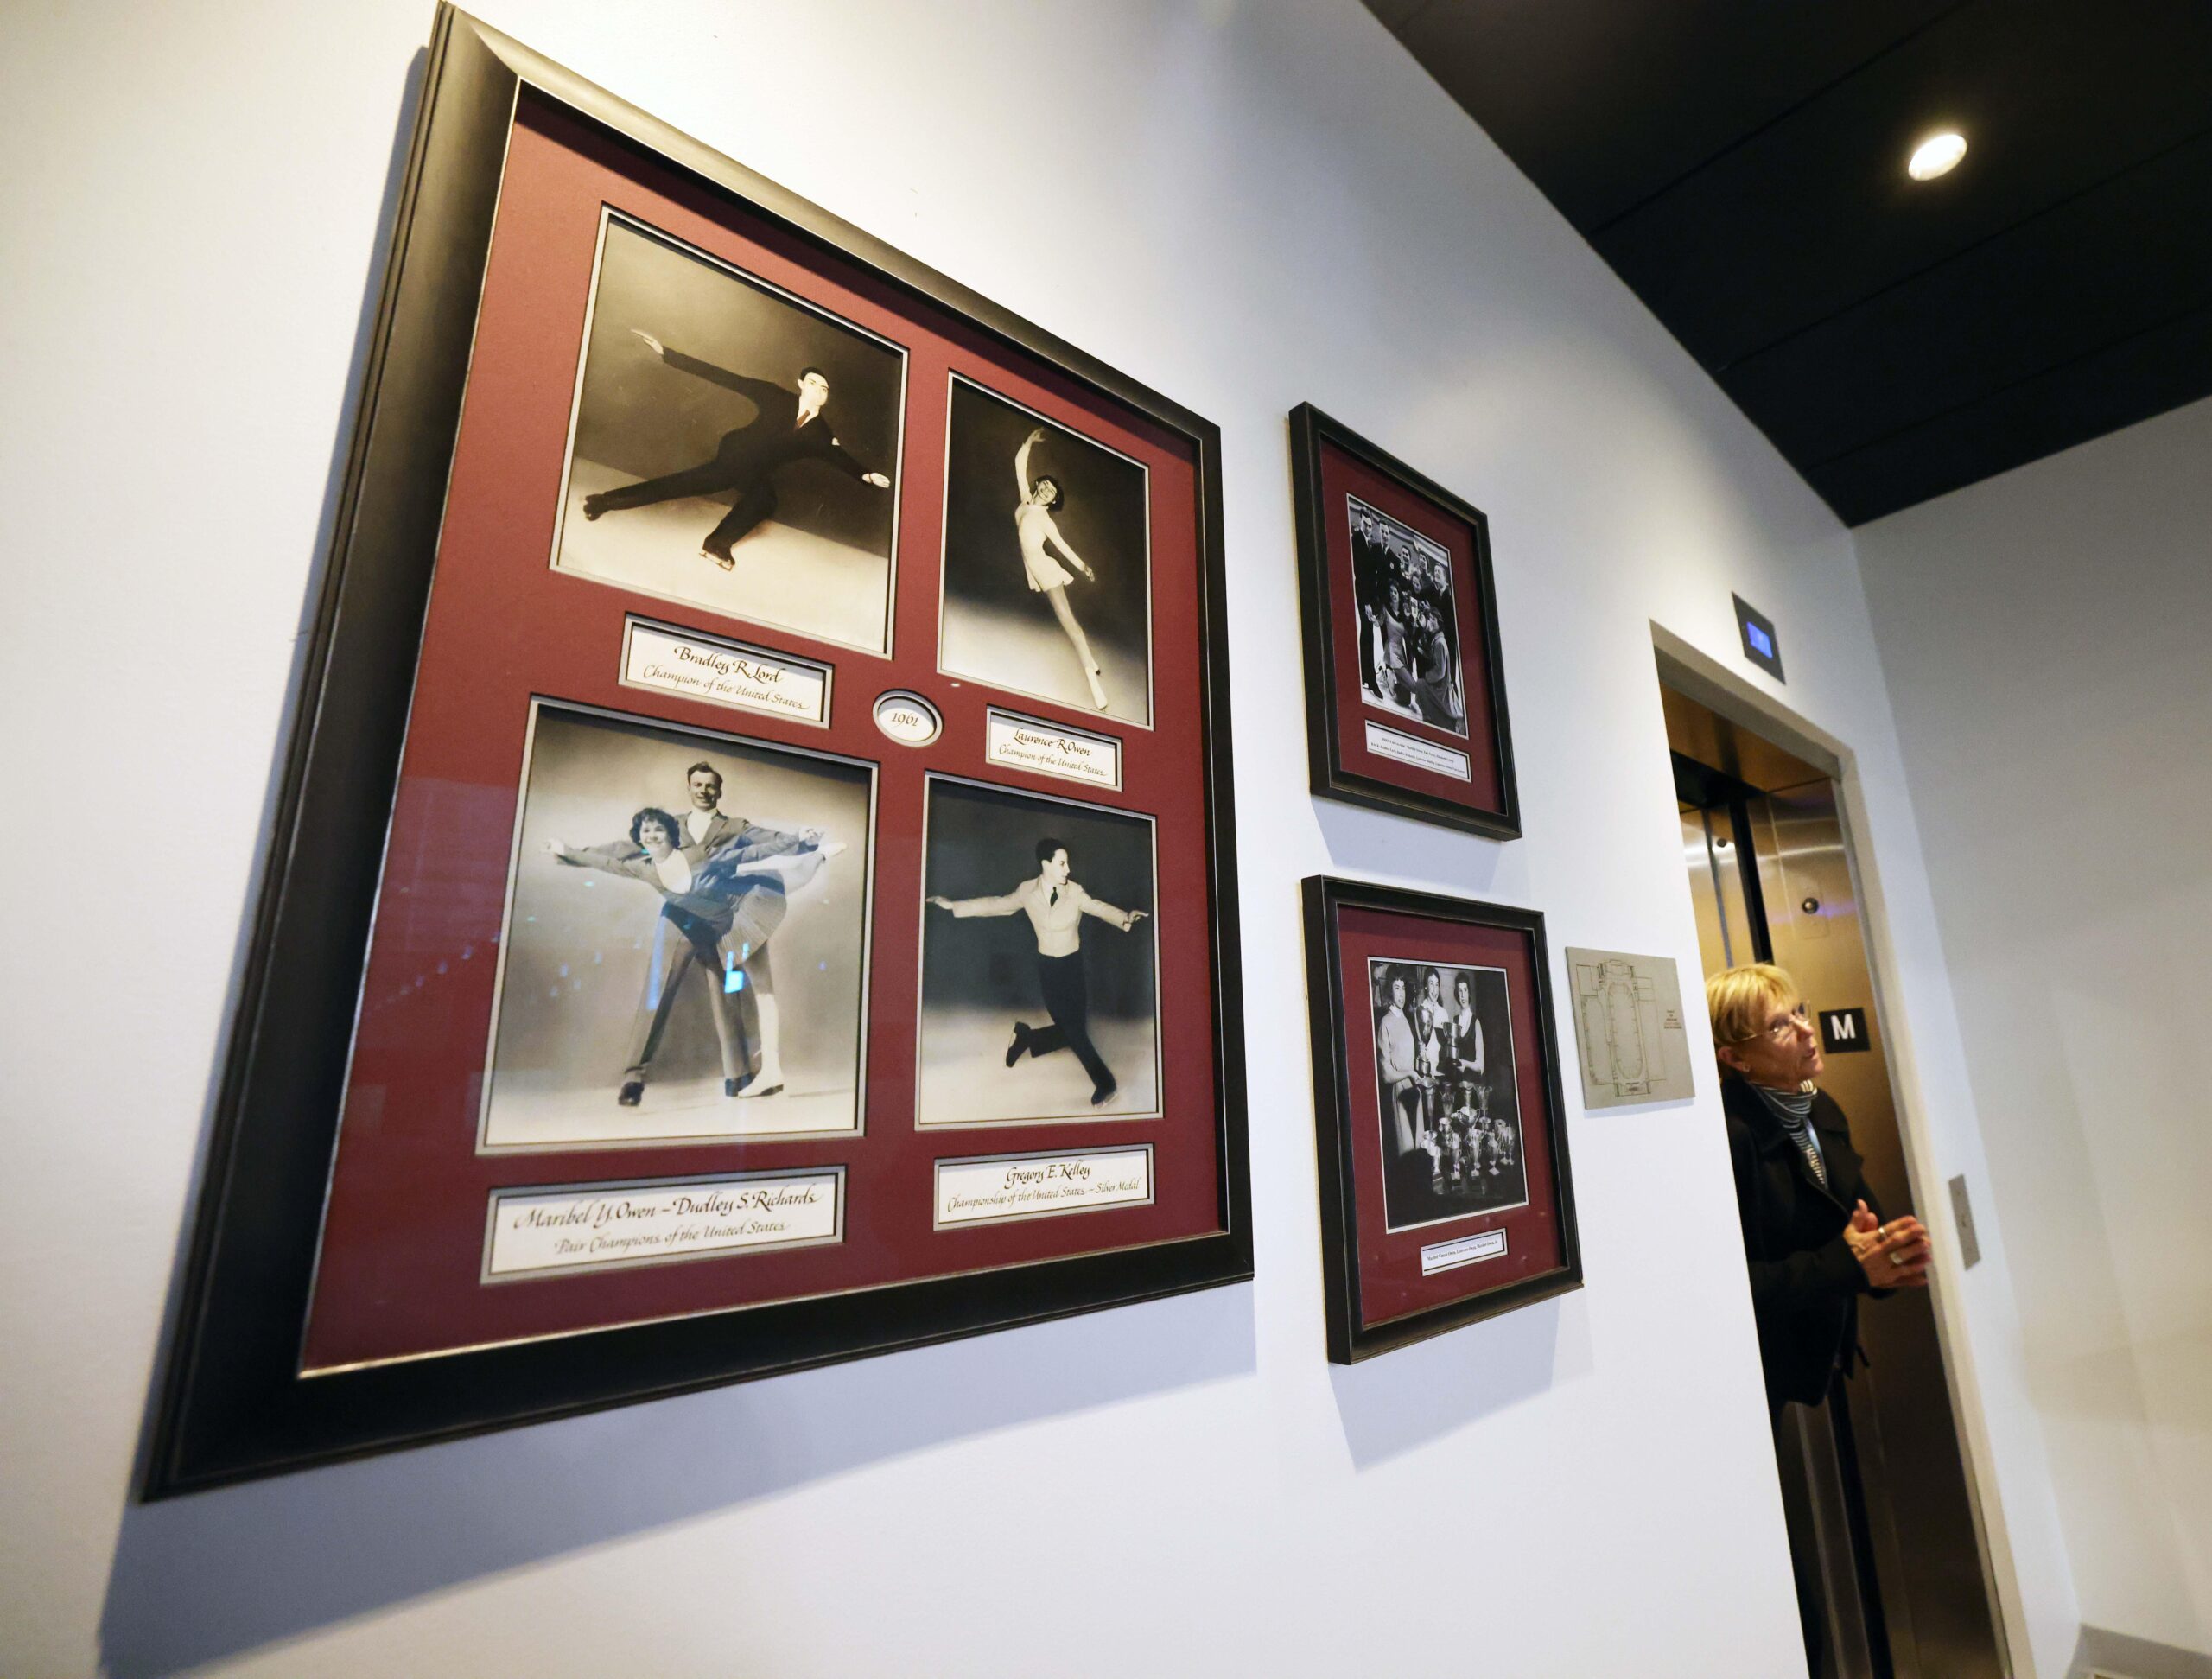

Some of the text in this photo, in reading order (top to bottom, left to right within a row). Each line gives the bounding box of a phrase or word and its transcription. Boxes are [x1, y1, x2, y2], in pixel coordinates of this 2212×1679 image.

[674, 646, 730, 675] Bradley
[753, 664, 785, 684] Lord
[644, 665, 810, 709] Champion of the United States
[892, 712, 918, 728] 1961
[1013, 728, 1055, 747] Laurence
[1068, 741, 1092, 755] Owen
[999, 744, 1108, 776] Champion of the United States
[1831, 1014, 1856, 1040] M
[1004, 1160, 1090, 1189] Gregory E. Kelley
[514, 1201, 593, 1230] Maribel
[616, 1203, 657, 1218] Owen
[673, 1192, 734, 1217] Dudley
[736, 1192, 750, 1210] S.
[750, 1183, 821, 1212] Richards
[948, 1192, 1007, 1212] Championship
[1007, 1192, 1017, 1207] of
[1018, 1190, 1032, 1201] the
[1033, 1186, 1058, 1199] United
[1060, 1186, 1085, 1197] States
[1095, 1180, 1116, 1193] Silver
[1116, 1178, 1141, 1192] Medal
[555, 1219, 791, 1255] Pair Champions of the United States
